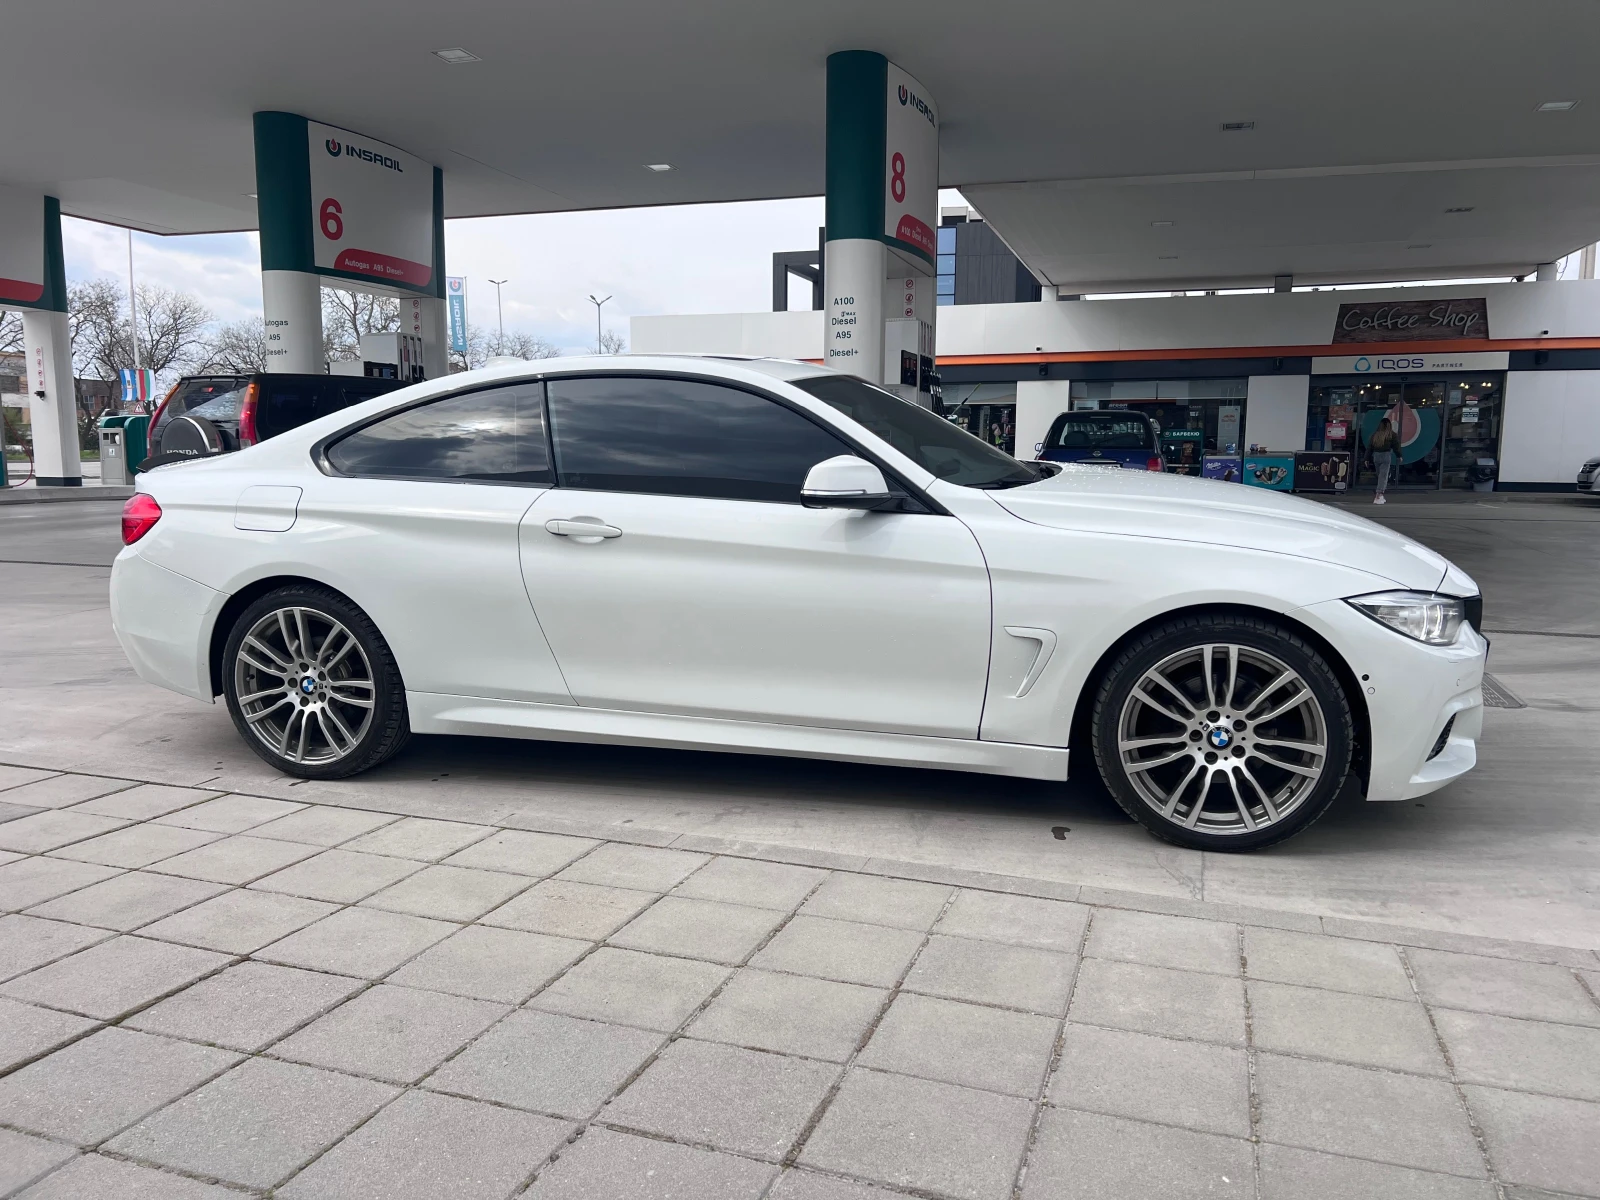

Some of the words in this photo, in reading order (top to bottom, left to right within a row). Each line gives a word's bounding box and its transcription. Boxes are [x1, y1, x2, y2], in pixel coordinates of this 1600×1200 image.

[345, 144, 404, 173] INSAOIL
[891, 152, 906, 204] 8
[319, 197, 344, 241] 6
[344, 258, 370, 270] Autogas
[373, 262, 384, 272] A95
[833, 296, 855, 306] A100
[831, 316, 857, 326] Diesel
[1342, 306, 1421, 331] Coffee
[1428, 304, 1480, 335] Shop
[268, 333, 281, 341] A95
[835, 330, 852, 340] A95
[829, 348, 859, 357] Diesel+
[1377, 358, 1424, 371] IQOS
